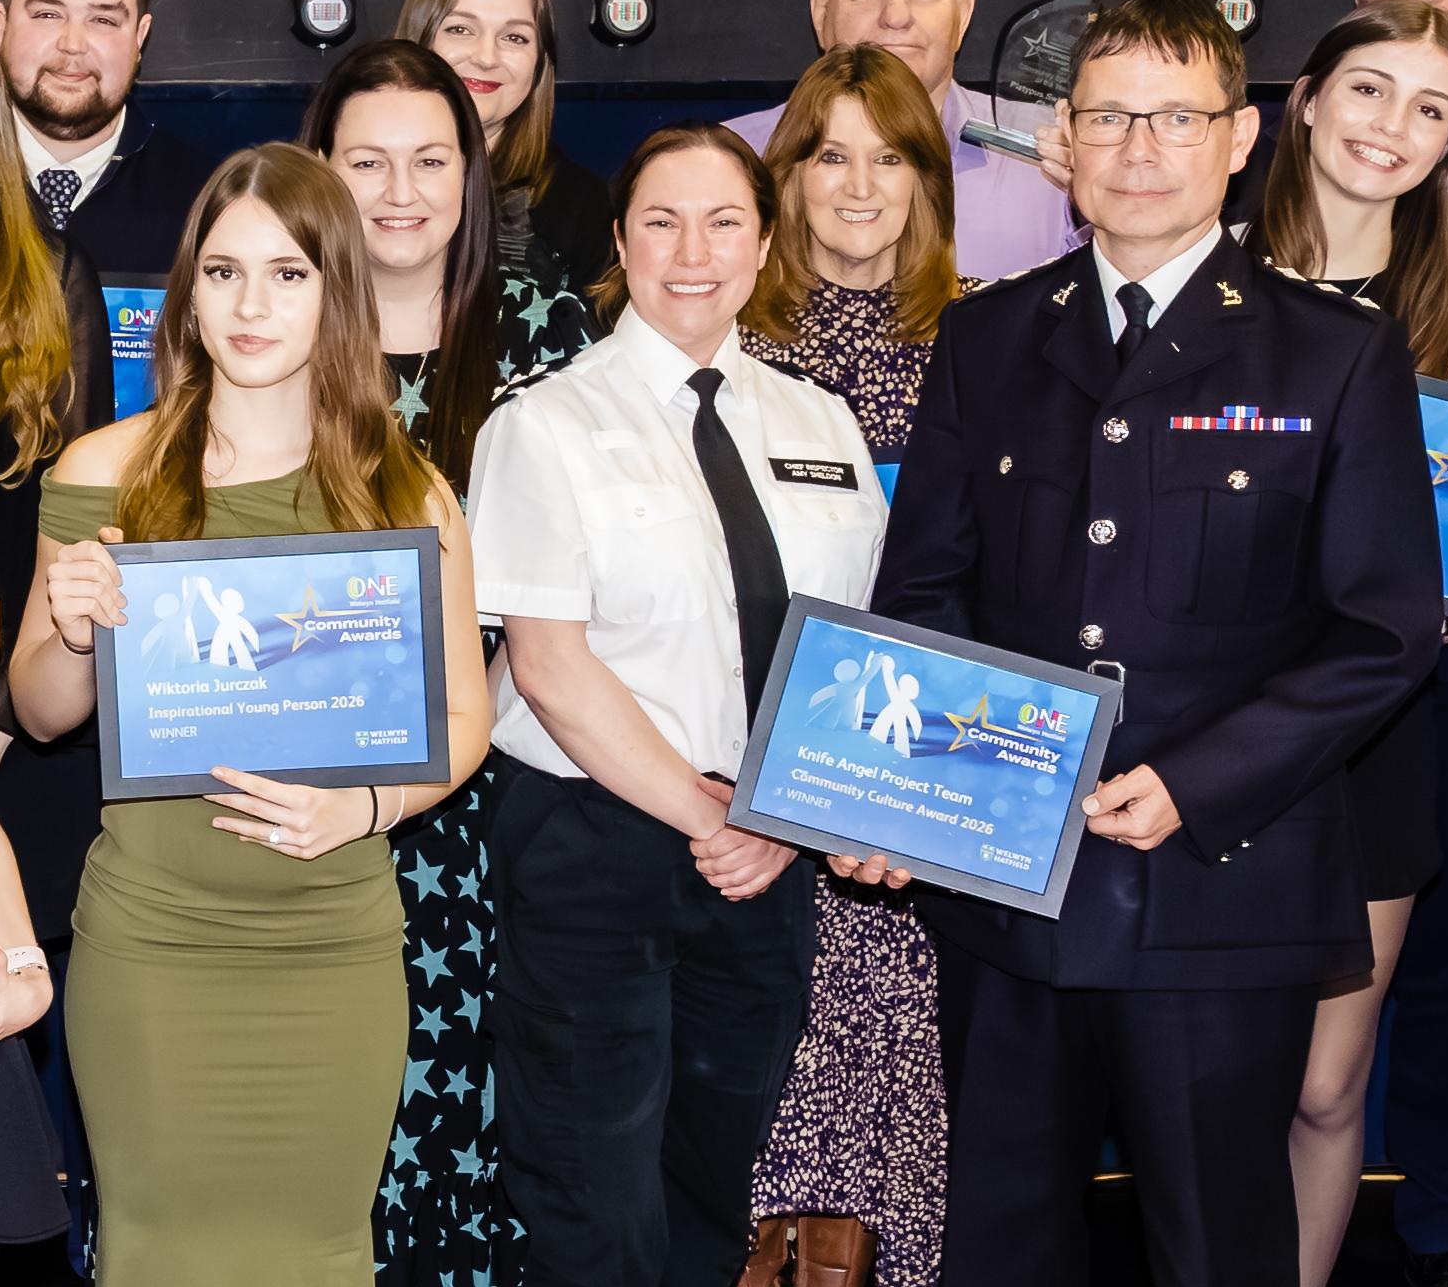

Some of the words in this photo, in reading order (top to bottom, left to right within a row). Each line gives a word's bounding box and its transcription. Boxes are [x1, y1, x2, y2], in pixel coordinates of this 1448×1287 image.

[784, 463, 804, 471] CHIEF
[806, 464, 844, 474] INSPECTOR
[347, 575, 398, 600] ONE
[304, 616, 401, 631] Community
[339, 629, 402, 642] Awards
[147, 681, 210, 696] Wiktoria
[213, 677, 267, 692] Jurczak
[148, 704, 233, 721] Inspirational
[236, 702, 279, 715] Young
[283, 699, 327, 711] Person
[331, 695, 365, 709] 2026
[1018, 702, 1071, 734] ONE
[150, 726, 197, 739] WINNER
[370, 729, 408, 737] WELWYN
[371, 737, 408, 745] HATFIELD
[967, 728, 1061, 763] Community
[996, 749, 1058, 774] Awards
[797, 746, 834, 767] Knife
[836, 757, 877, 779] Angel
[880, 768, 930, 794] Project
[933, 783, 973, 806] Team
[786, 787, 832, 810] WINNER
[791, 768, 865, 800] Community
[867, 790, 914, 813] Culture
[916, 804, 958, 825] Award
[960, 816, 995, 835] 2026
[994, 855, 1029, 870] HATFIELD
[996, 848, 1032, 864] WELWYN
